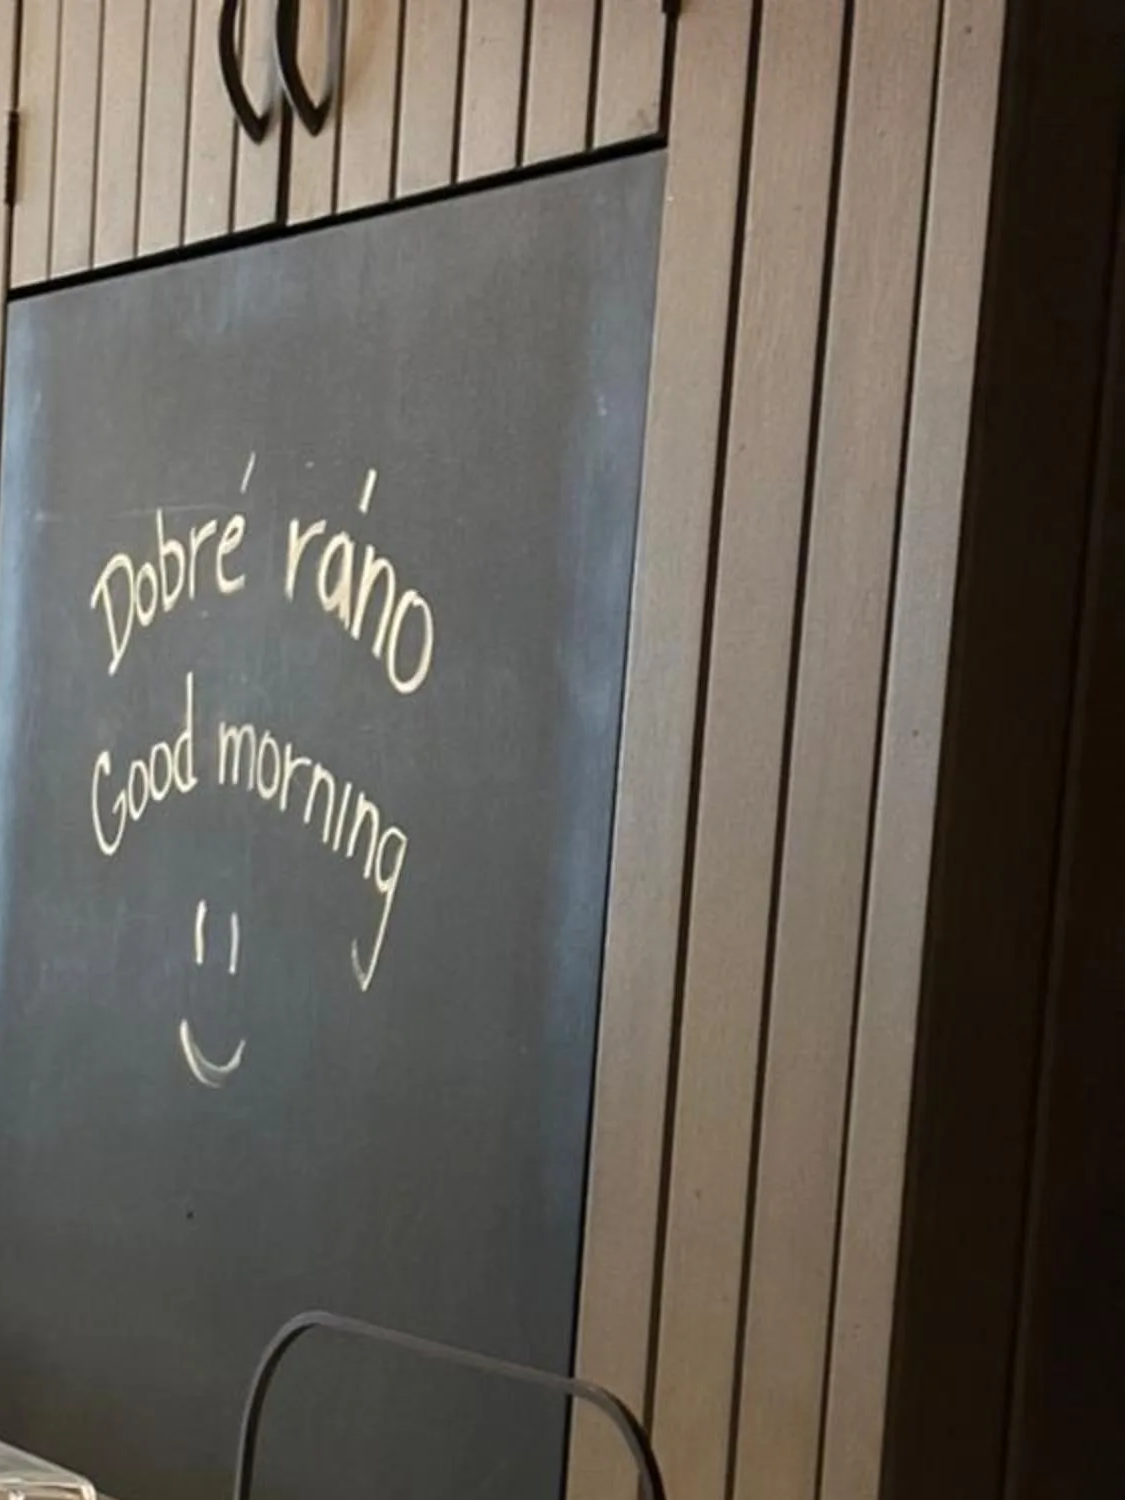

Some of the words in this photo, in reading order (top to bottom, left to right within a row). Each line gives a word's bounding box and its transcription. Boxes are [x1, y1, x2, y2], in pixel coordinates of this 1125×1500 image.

[90, 451, 256, 676] Dobré
[285, 469, 434, 694] ráno
[91, 672, 198, 855] Good
[218, 720, 408, 992] morning
